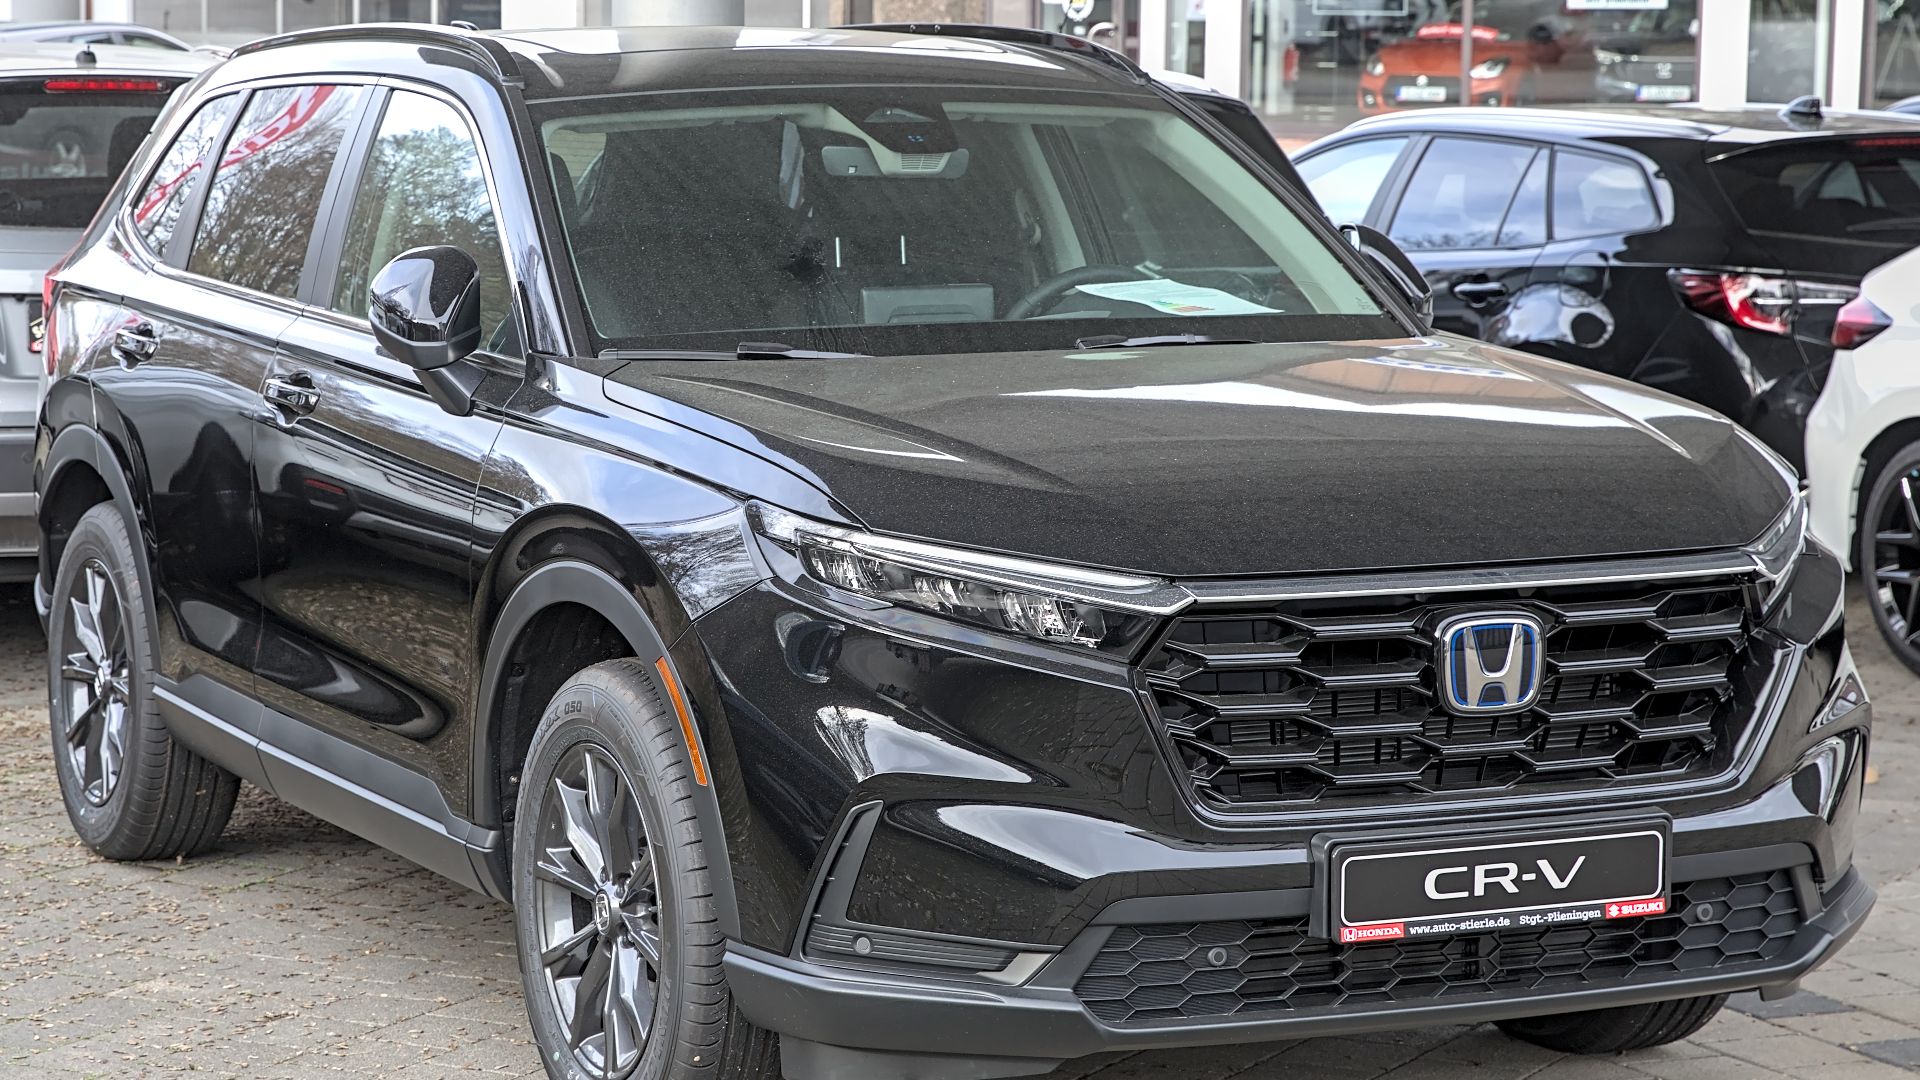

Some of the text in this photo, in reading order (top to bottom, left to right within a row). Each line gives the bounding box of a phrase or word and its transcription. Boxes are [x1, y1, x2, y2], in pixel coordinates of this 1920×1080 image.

[564, 701, 583, 715] 050
[1424, 855, 1586, 900] CR-V
[1358, 927, 1402, 938] HONDA
[1409, 916, 1511, 935] www.auto-stierle.de
[1519, 908, 1602, 926] Stgt.-Plieningen
[1620, 901, 1664, 915] SUZUKI
